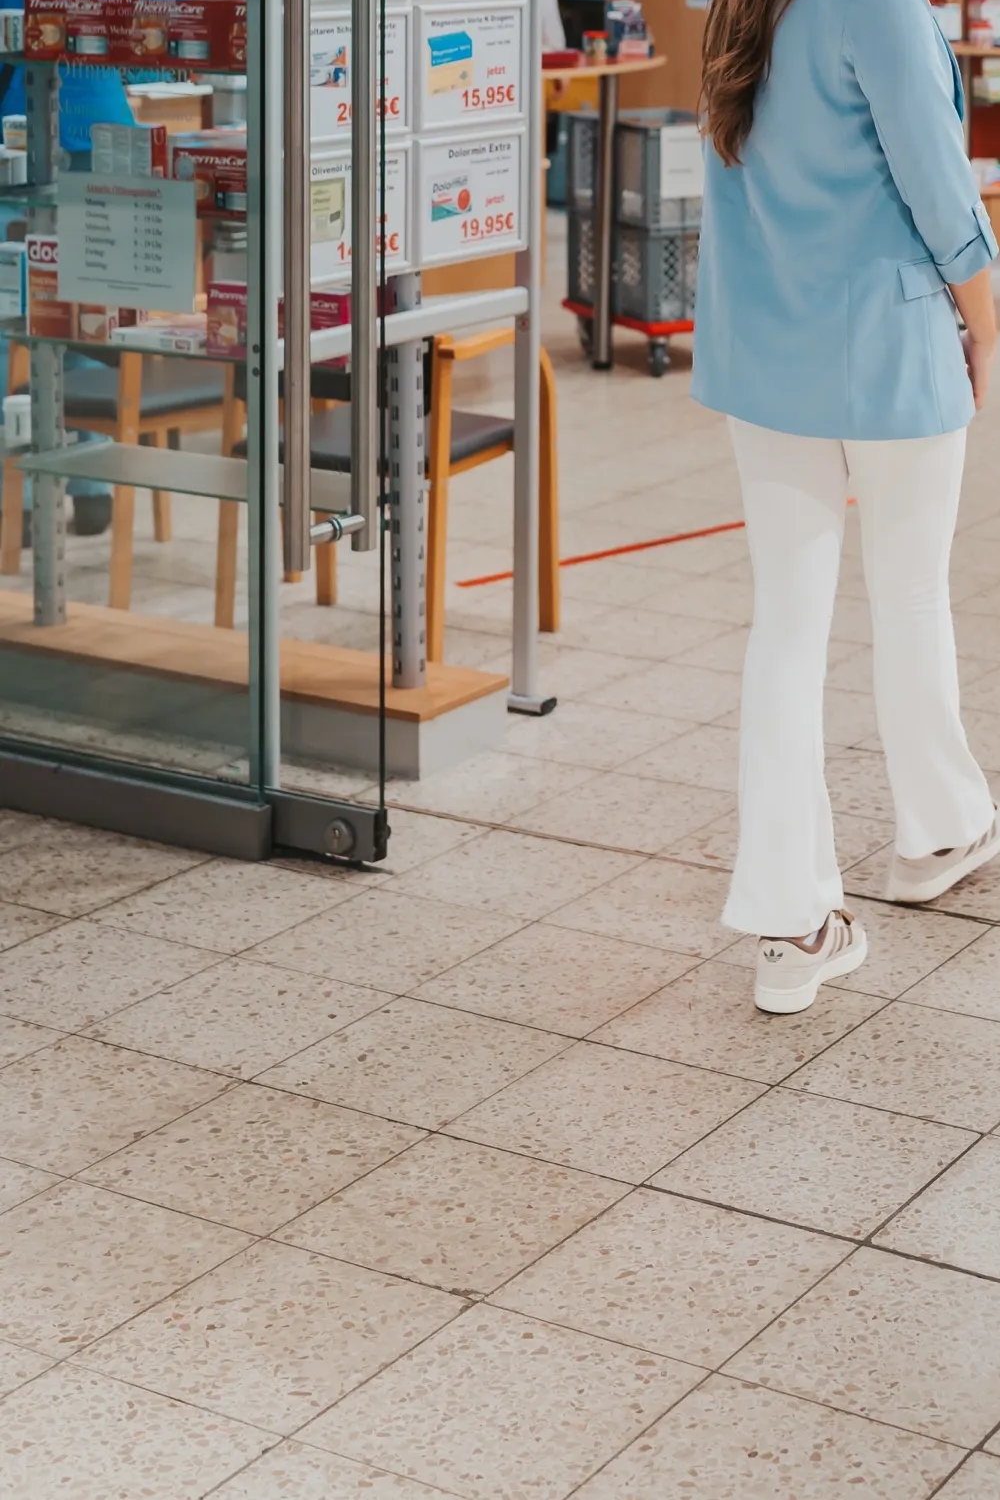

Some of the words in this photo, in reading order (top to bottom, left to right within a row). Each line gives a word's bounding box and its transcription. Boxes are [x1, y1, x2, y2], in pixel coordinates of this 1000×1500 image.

[134, 0, 205, 14] ThermaCare
[487, 65, 506, 79] jetzt
[462, 84, 516, 110] 15,95€
[449, 146, 486, 159] Dolormin
[489, 143, 511, 154] Extra
[311, 165, 343, 176] Olivenöl
[485, 195, 505, 208] jetzt
[461, 212, 515, 239] 19,95€
